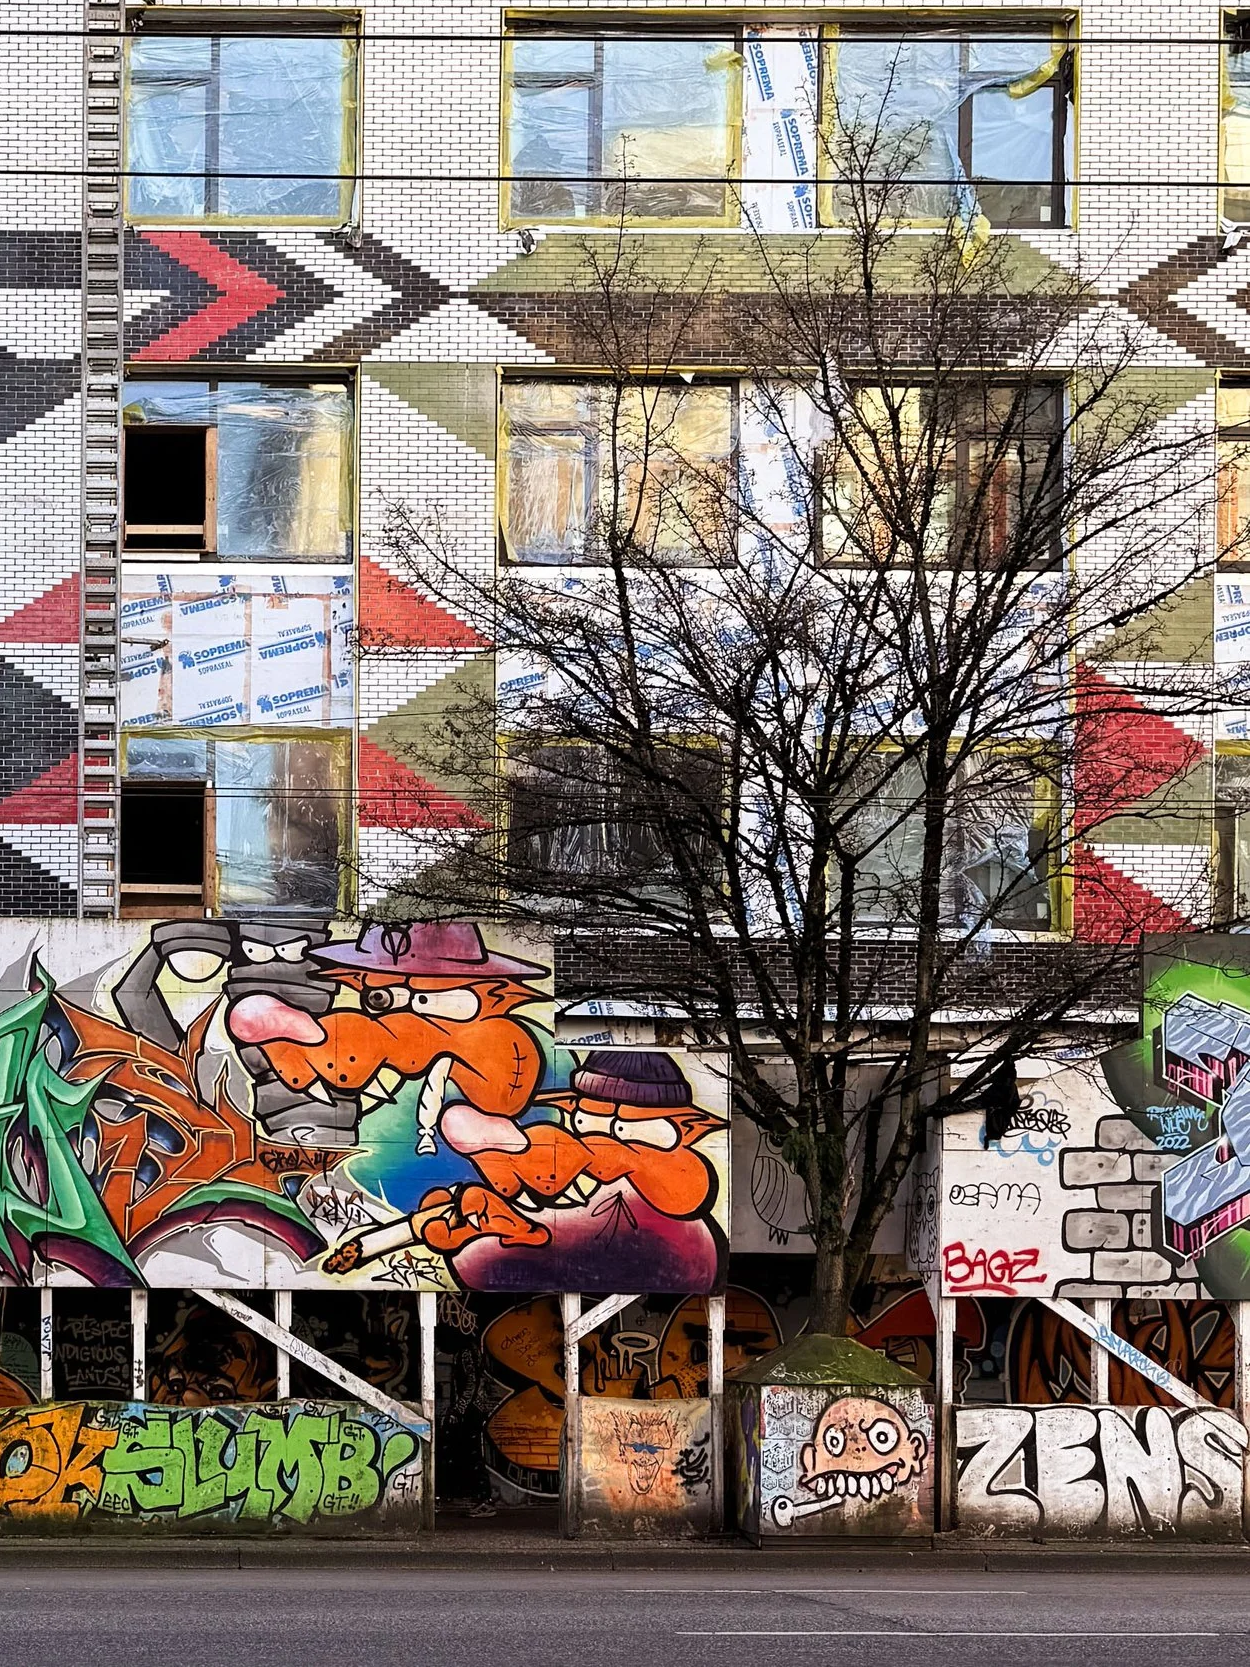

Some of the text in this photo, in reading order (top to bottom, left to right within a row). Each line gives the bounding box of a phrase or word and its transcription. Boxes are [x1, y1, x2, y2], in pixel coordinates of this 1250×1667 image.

[752, 43, 775, 101] SOPREMA
[788, 118, 808, 176] SOPREMA
[279, 624, 312, 637] SOPRASEAL
[194, 639, 250, 660] SOPREMA
[259, 638, 316, 659] SOPREMA
[198, 660, 234, 675] SOPRASEAL
[198, 696, 233, 709] SOPRASEAL
[273, 684, 329, 705] SOPREMA
[277, 705, 311, 719] SOPRASEAL
[1155, 1135, 1192, 1150] 2022
[63, 1315, 132, 1344] RESPEC
[956, 1404, 1250, 1533] ZENS
